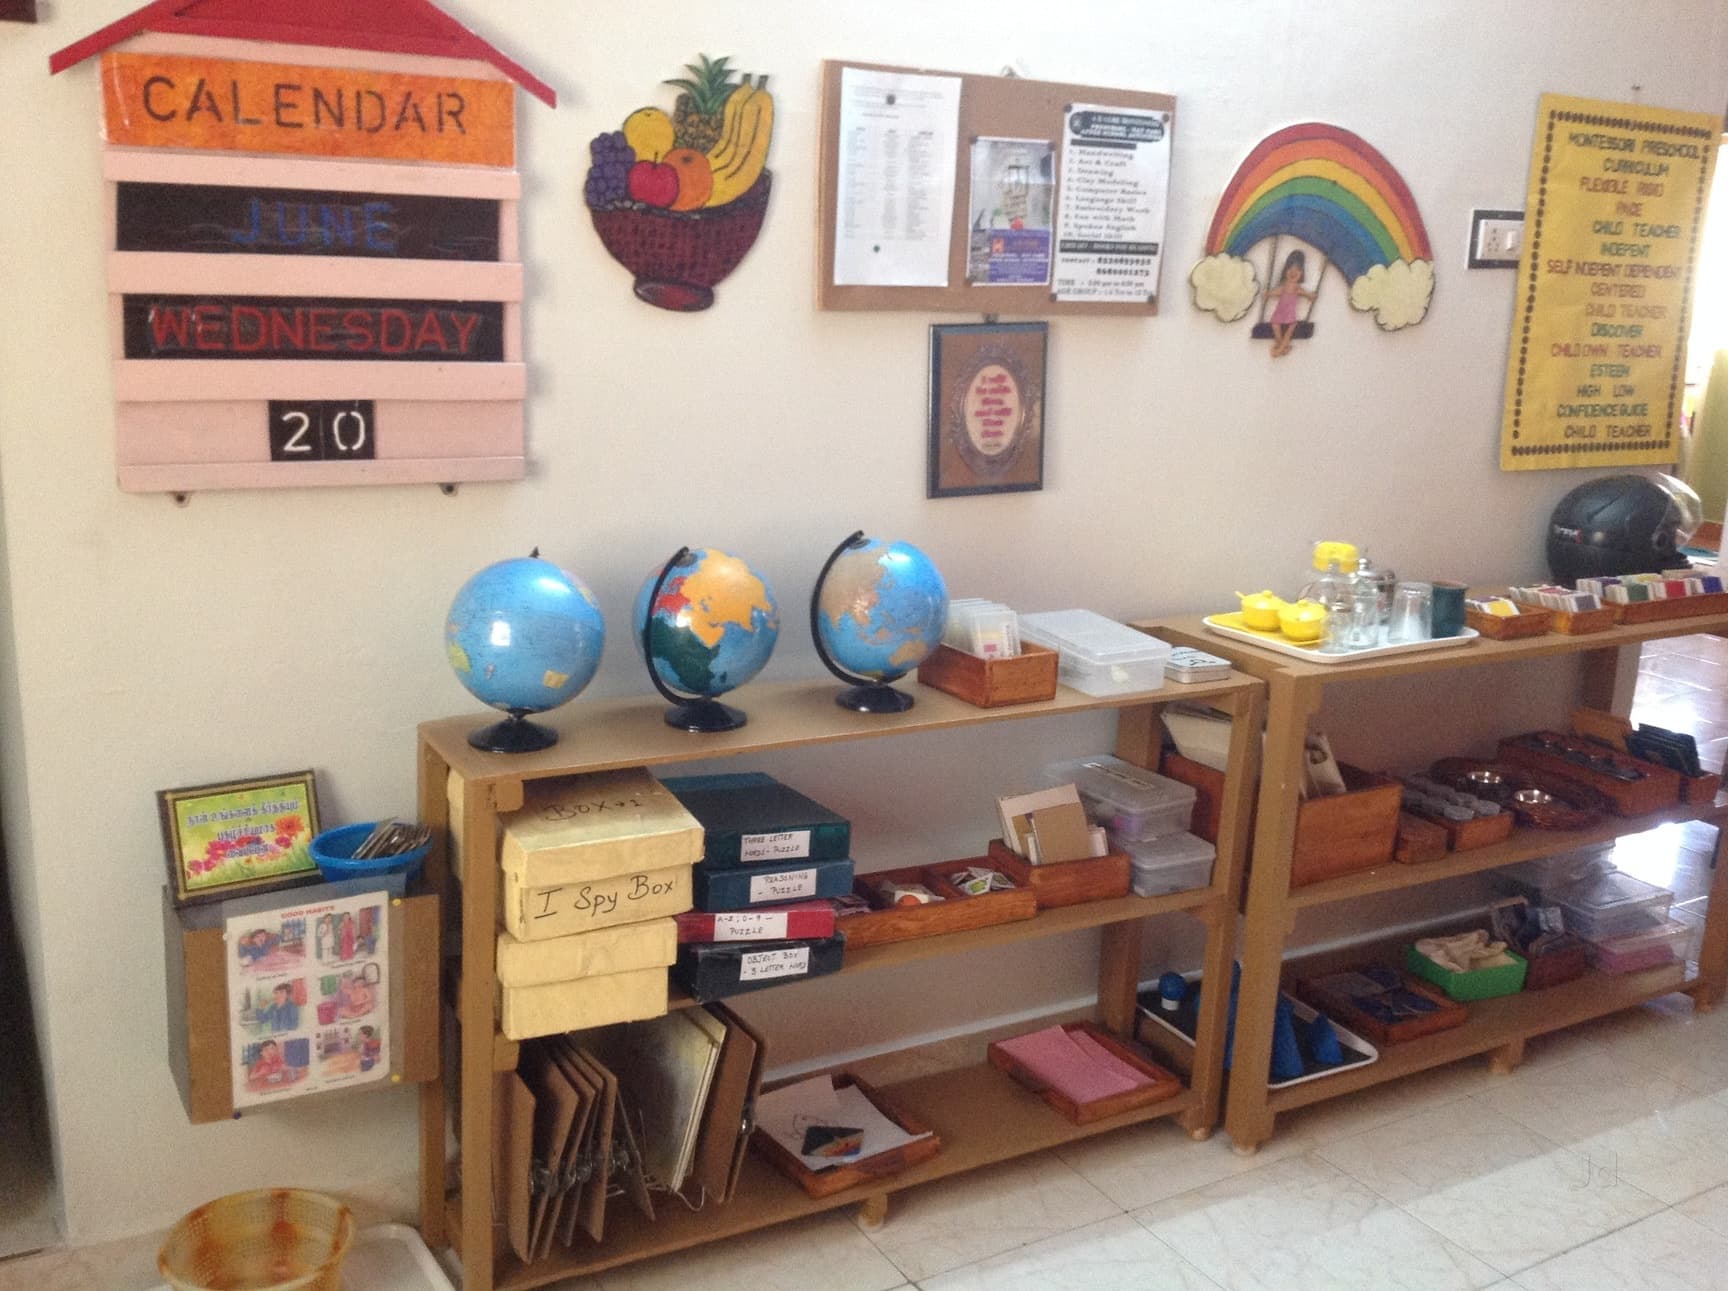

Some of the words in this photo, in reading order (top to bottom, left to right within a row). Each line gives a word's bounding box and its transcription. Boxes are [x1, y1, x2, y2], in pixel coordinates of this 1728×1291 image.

[142, 75, 469, 135] CALENDAR
[1569, 132, 1636, 153] MONTESSORI
[1642, 139, 1700, 159] PRESCHOOL
[1603, 157, 1670, 176] CURRICULUM
[231, 197, 396, 252] JUNE
[1592, 219, 1624, 235] CHILD
[1633, 222, 1682, 239] TEACHER
[1546, 258, 1573, 274] SELF
[1584, 303, 1617, 318] CHILD
[1619, 303, 1668, 319] TEACHER
[148, 305, 481, 355] WEDNESDAY
[1590, 322, 1644, 338] DISCOVER
[1551, 342, 1581, 358] CHILD
[1617, 343, 1663, 359] TEACHER
[1576, 383, 1601, 398] HIGH
[1612, 383, 1636, 398] LOW
[1556, 403, 1619, 418] CONFIDENCE
[1619, 403, 1649, 418] GUIDE
[1564, 424, 1597, 439] CHILD
[1605, 424, 1652, 439] TEACHER
[744, 836, 765, 845] THREE
[769, 833, 793, 843] LETTER
[773, 845, 800, 853] PUZZLE
[764, 871, 808, 884] REASONING
[534, 887, 563, 920] I
[574, 886, 619, 918] Spy
[627, 874, 674, 901] Box
[770, 884, 803, 895] PUZZLE
[281, 910, 304, 919] GOOD
[305, 904, 335, 915] HABITS
[730, 926, 764, 936] PUZZLE
[747, 952, 777, 965] OBJECT
[760, 964, 784, 974] LETTER
